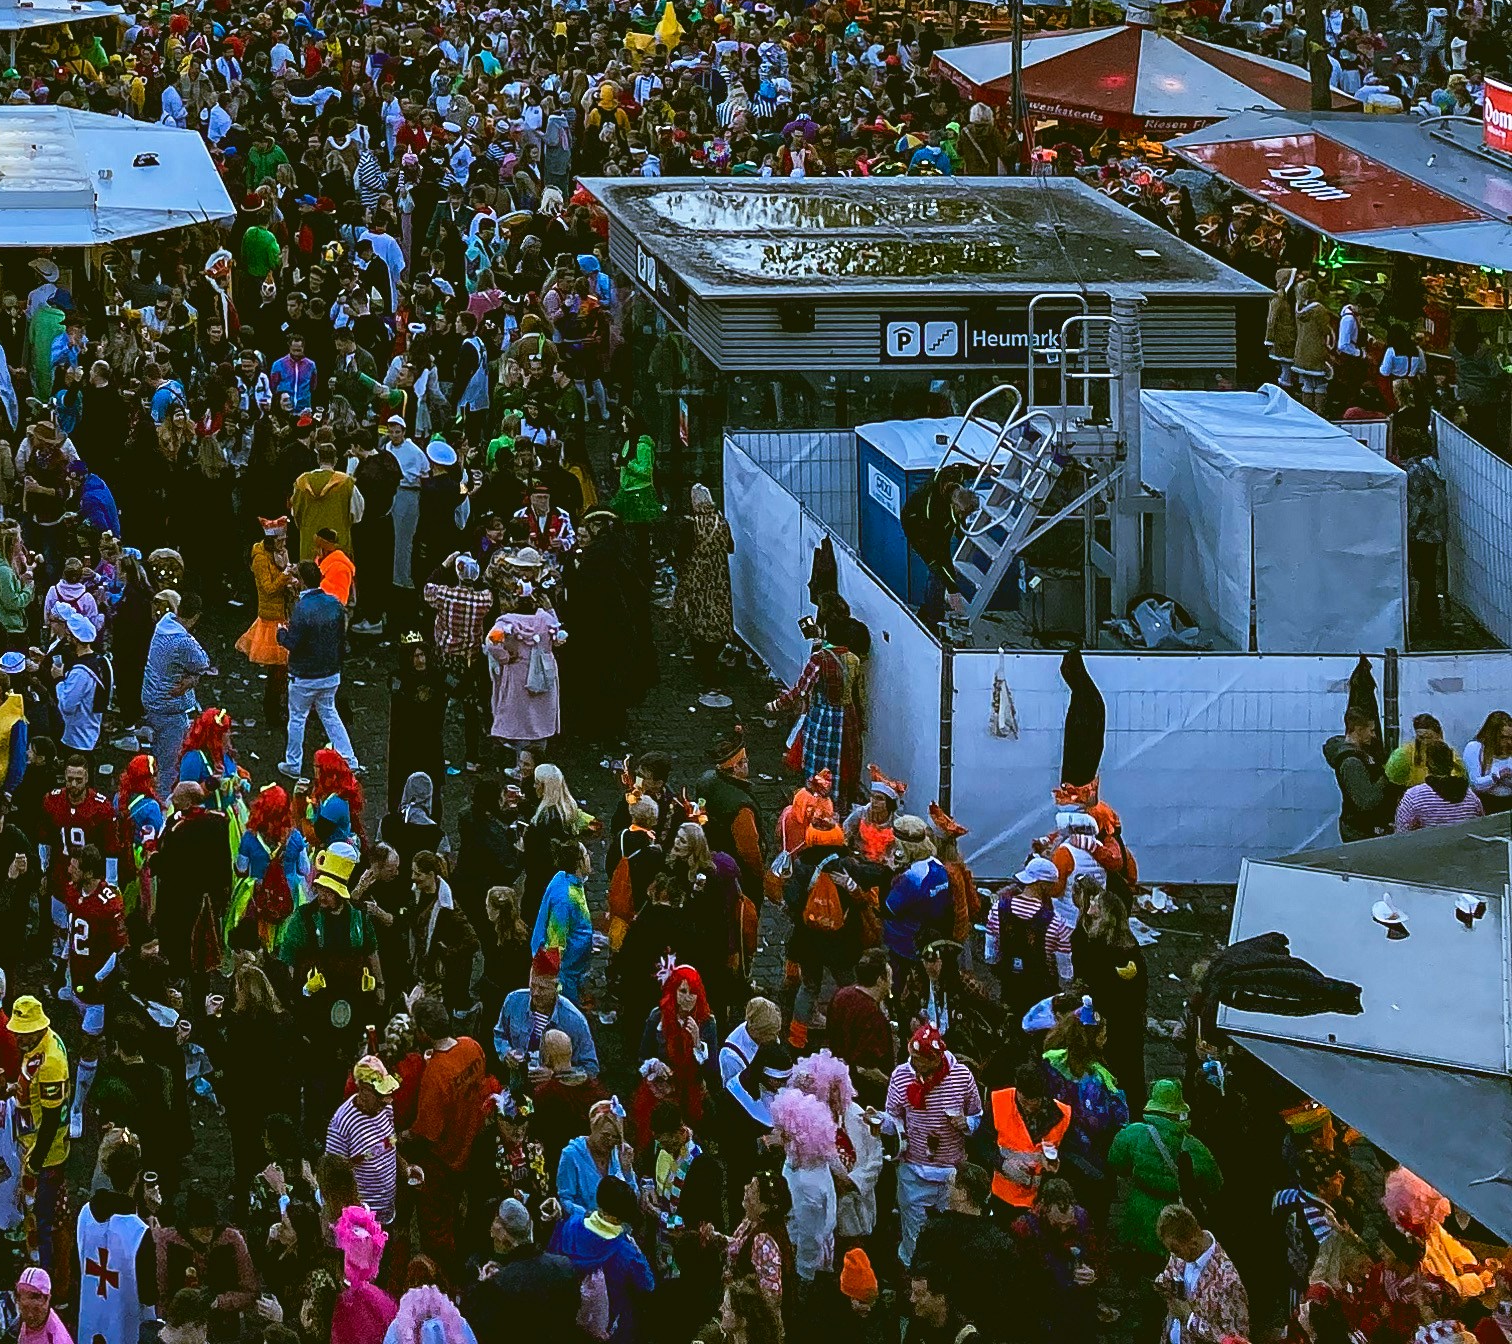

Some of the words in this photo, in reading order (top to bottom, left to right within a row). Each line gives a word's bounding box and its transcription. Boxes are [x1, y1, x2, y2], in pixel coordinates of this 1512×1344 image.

[1484, 96, 1512, 131] Dom
[1267, 164, 1352, 202] Dom
[973, 329, 1067, 348] Heumark
